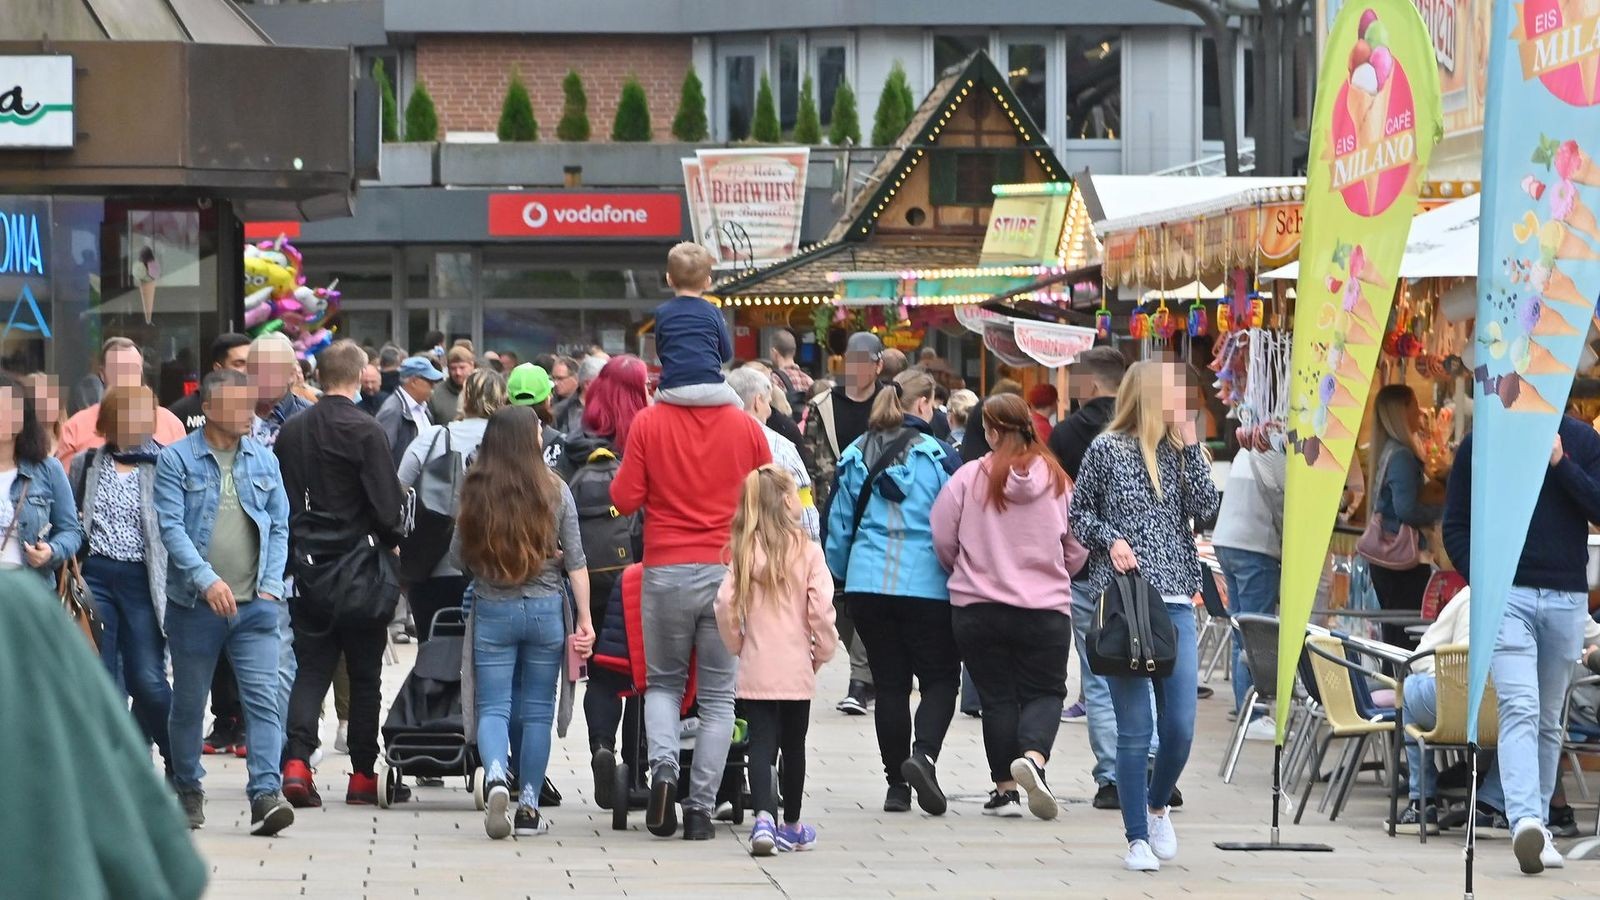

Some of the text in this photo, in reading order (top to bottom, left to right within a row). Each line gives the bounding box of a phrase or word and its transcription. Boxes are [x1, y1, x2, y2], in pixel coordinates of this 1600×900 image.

[1535, 8, 1557, 34] EIS
[1335, 134, 1355, 156] EIS
[1333, 133, 1414, 188] MILANO
[712, 179, 797, 204] Bratwurst
[553, 204, 648, 224] vodafone
[991, 217, 1037, 242] STUBE
